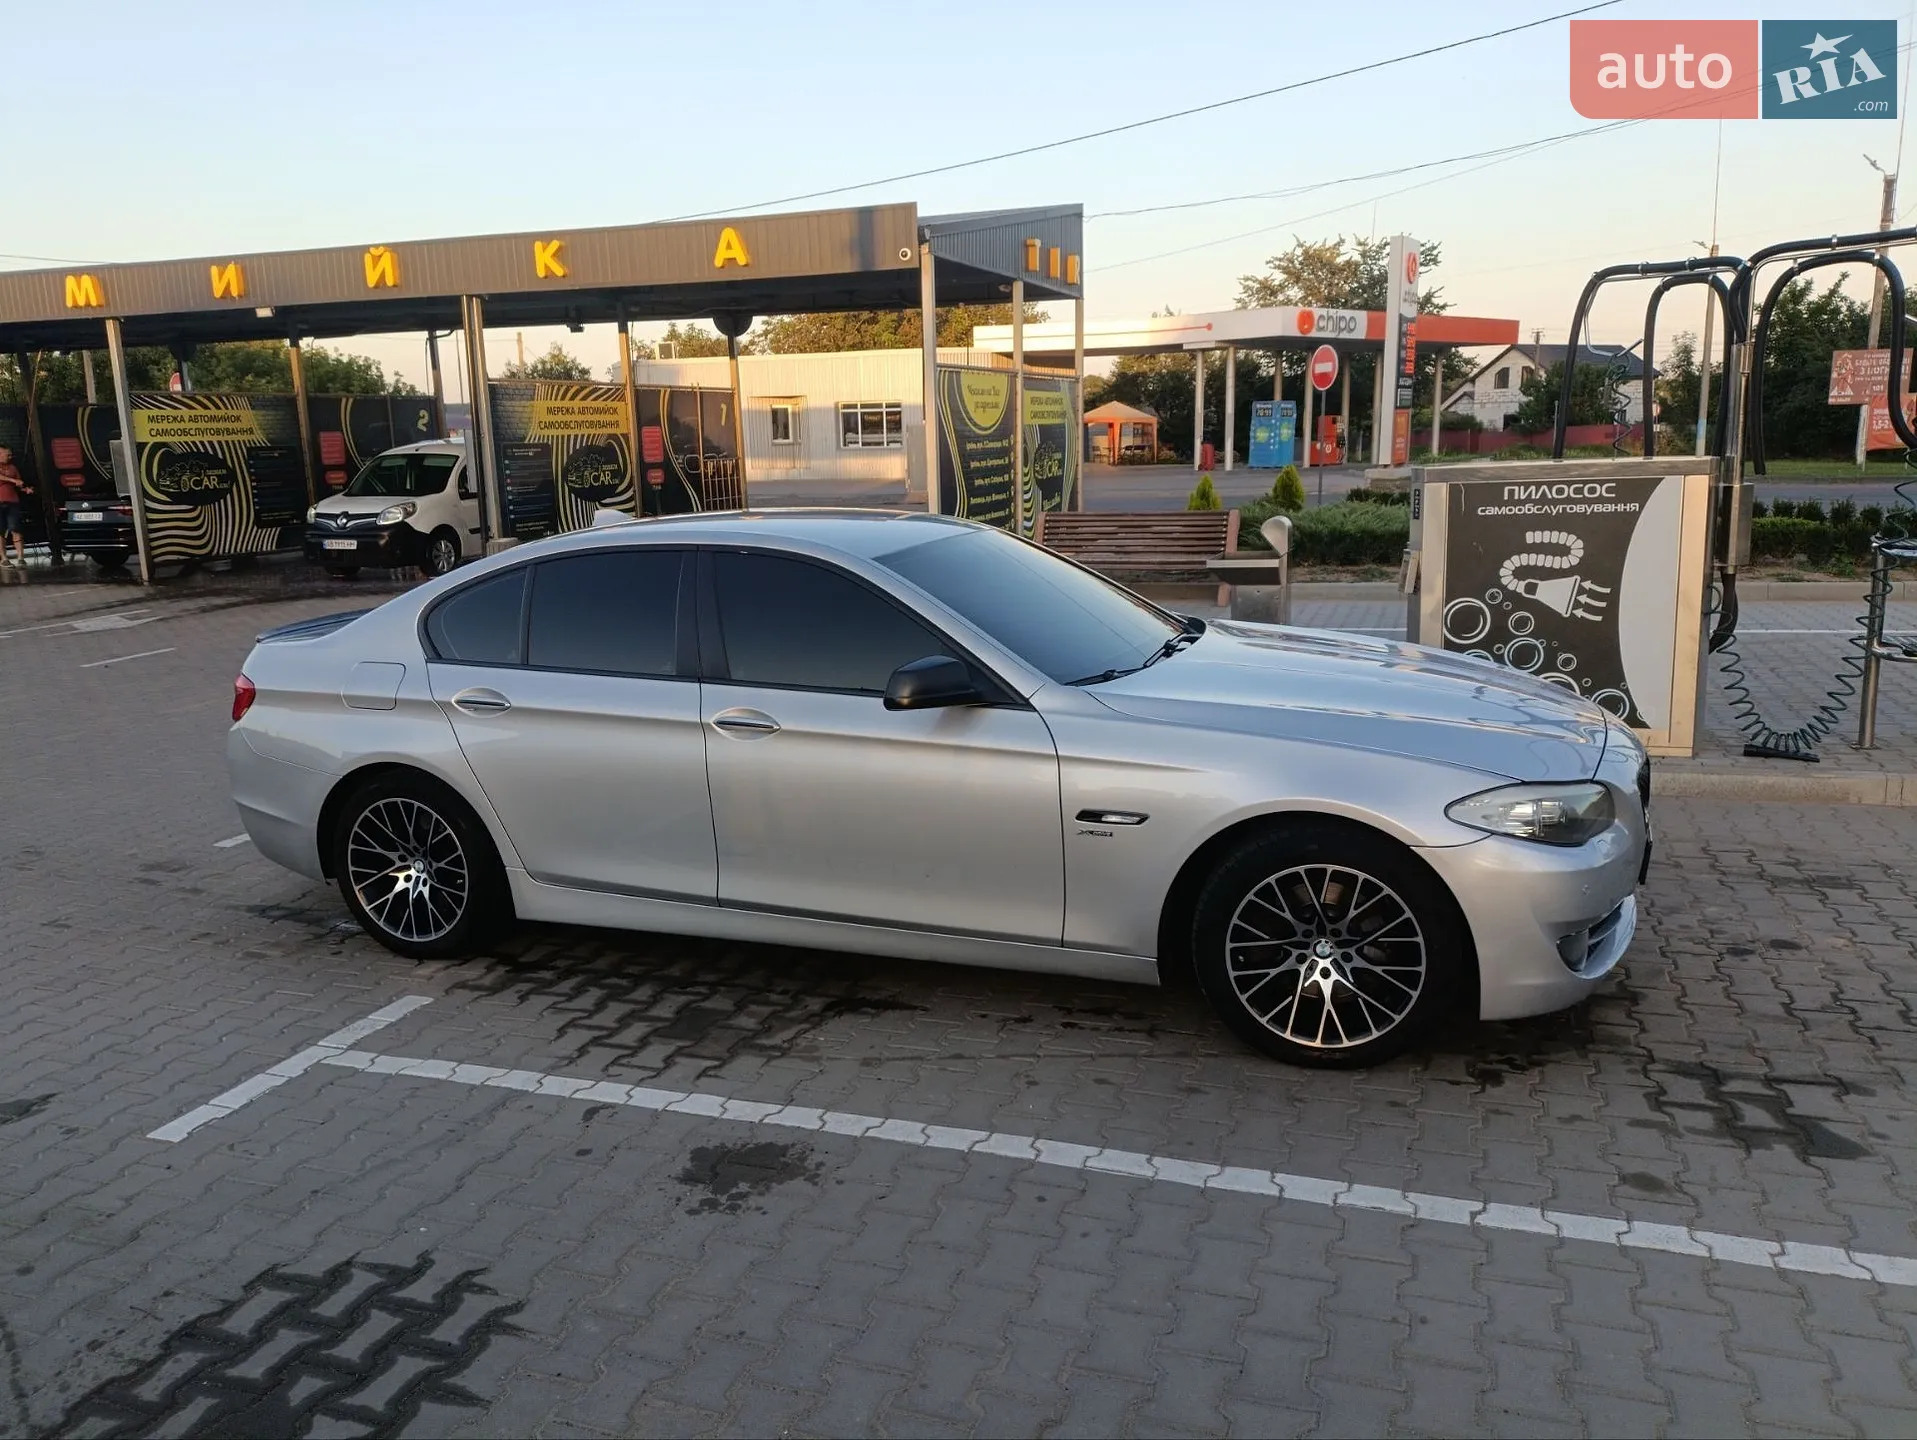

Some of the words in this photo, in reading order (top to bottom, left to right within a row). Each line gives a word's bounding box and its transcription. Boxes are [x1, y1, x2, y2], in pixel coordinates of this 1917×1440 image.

[1317, 311, 1357, 337] chipo
[547, 406, 576, 415] МЕРЕЖА
[577, 404, 618, 415] АВТОМИЙОК
[147, 414, 186, 425] МЕРЕЖА
[187, 413, 242, 424] АВТОМИЙОК
[539, 420, 620, 431] САМООБСЛУГОВУВАННЯ
[149, 426, 254, 438] САМООБСЛУГОВУВАННЯ
[190, 475, 219, 490] CAR
[591, 471, 613, 486] CAR
[1503, 482, 1617, 501] ПИЛОСОС
[1477, 502, 1641, 516] самообслуговування
